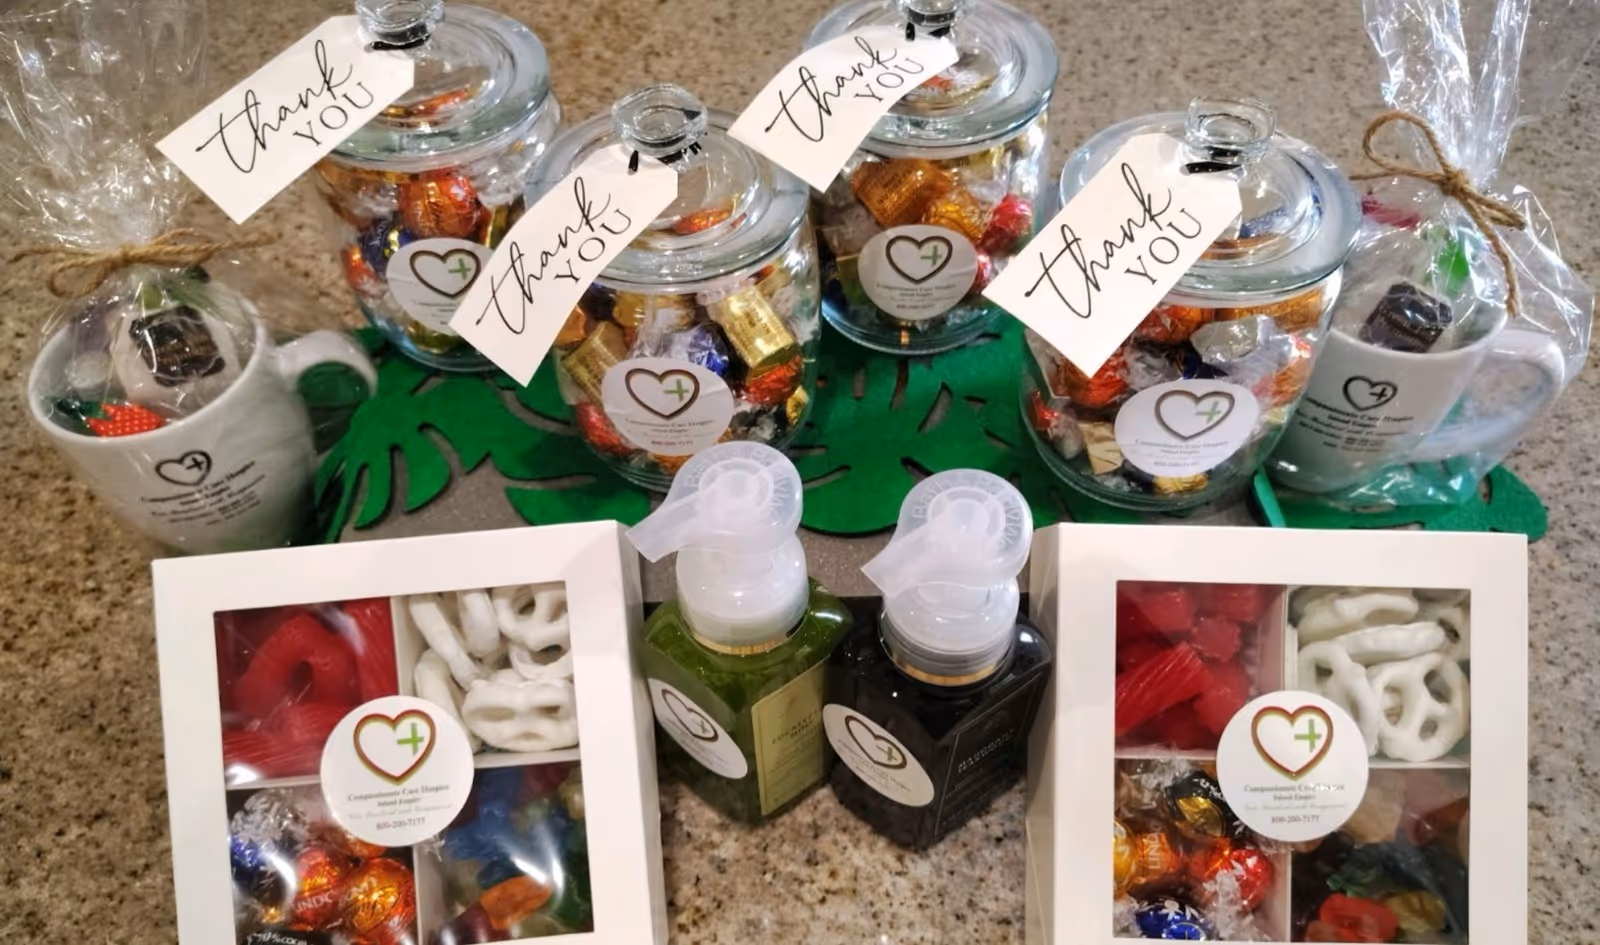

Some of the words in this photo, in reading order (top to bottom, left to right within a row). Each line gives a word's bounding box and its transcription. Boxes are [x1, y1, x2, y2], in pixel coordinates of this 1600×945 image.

[195, 40, 353, 173] thank
[293, 82, 374, 147] YOU
[765, 36, 899, 142] thank
[854, 57, 925, 102] YOU
[476, 176, 612, 335] thank
[554, 208, 632, 285] YOU
[1024, 161, 1173, 319] thank
[1125, 207, 1203, 286] YOU
